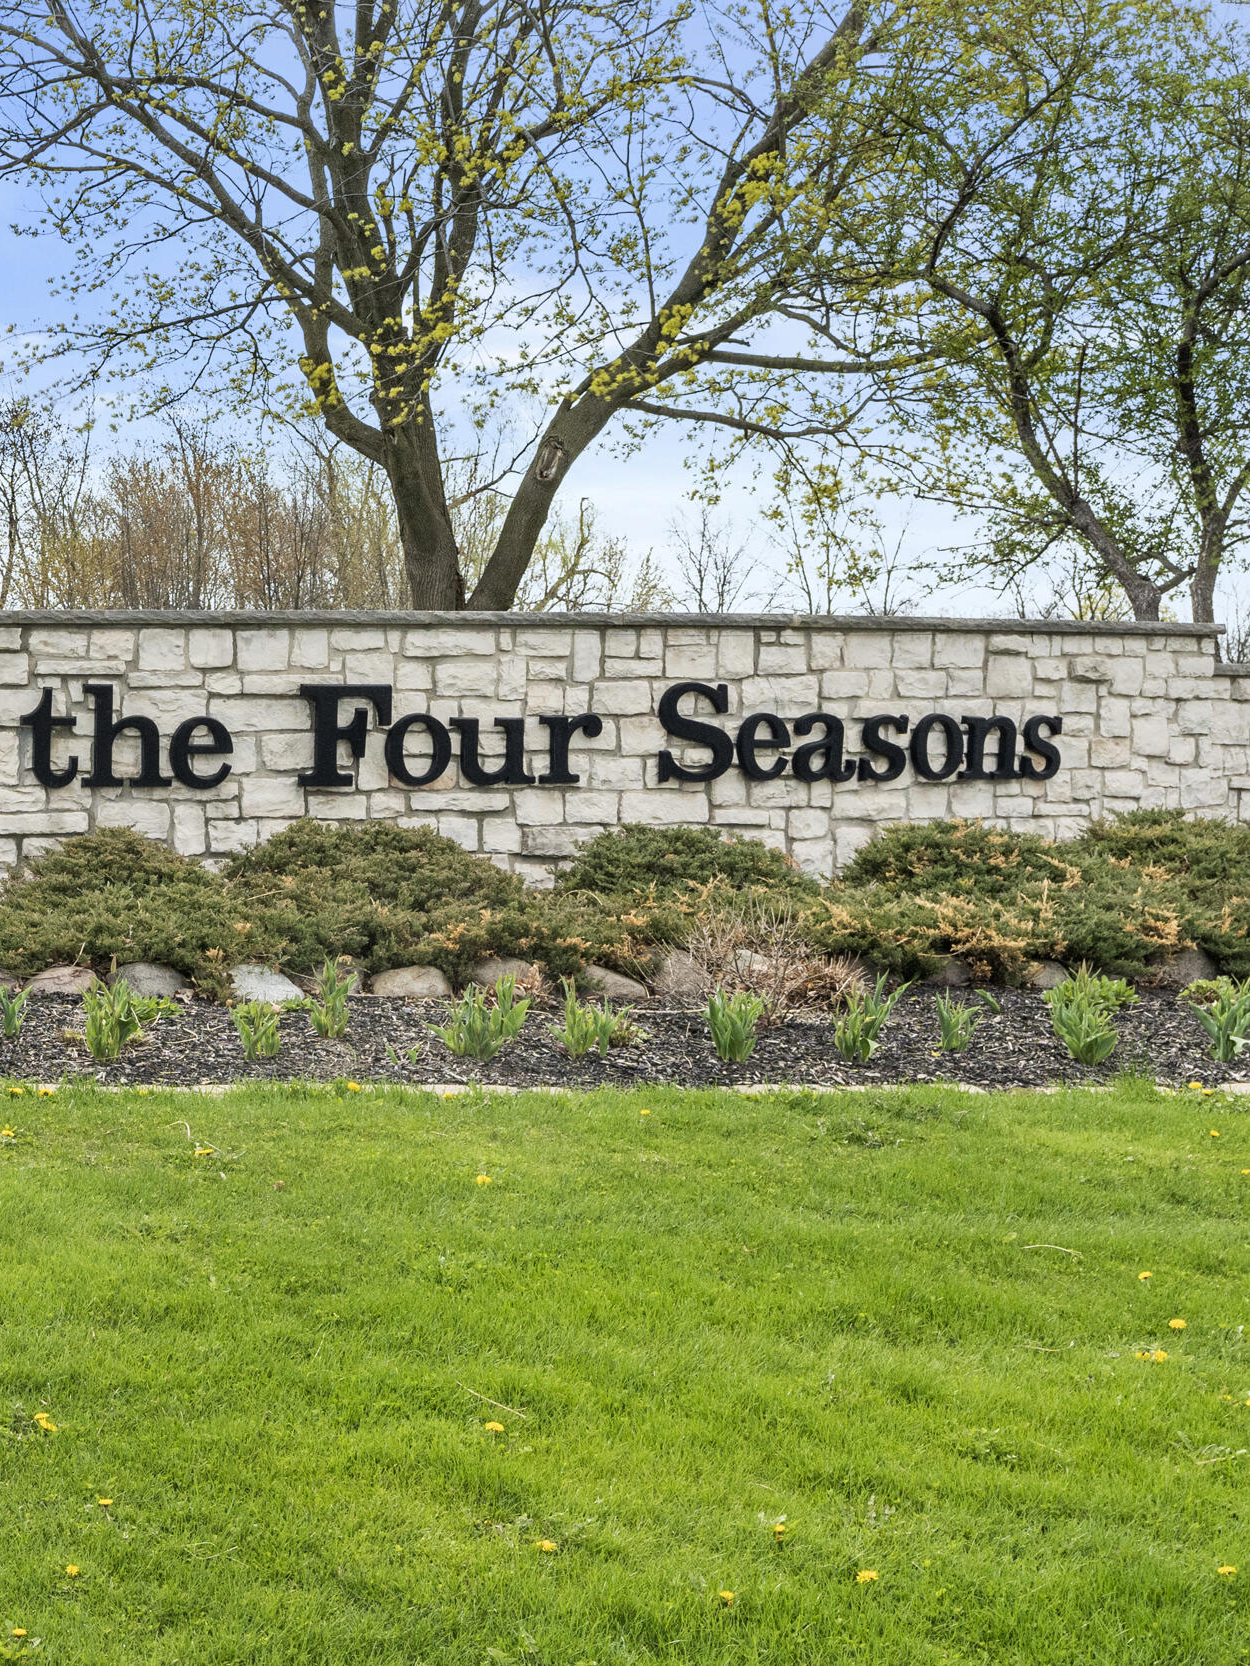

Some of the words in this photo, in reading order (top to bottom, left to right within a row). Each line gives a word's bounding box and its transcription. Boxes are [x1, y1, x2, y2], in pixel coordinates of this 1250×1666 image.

[20, 683, 233, 788] the
[299, 686, 603, 788] Four
[657, 681, 1063, 784] Seasons
